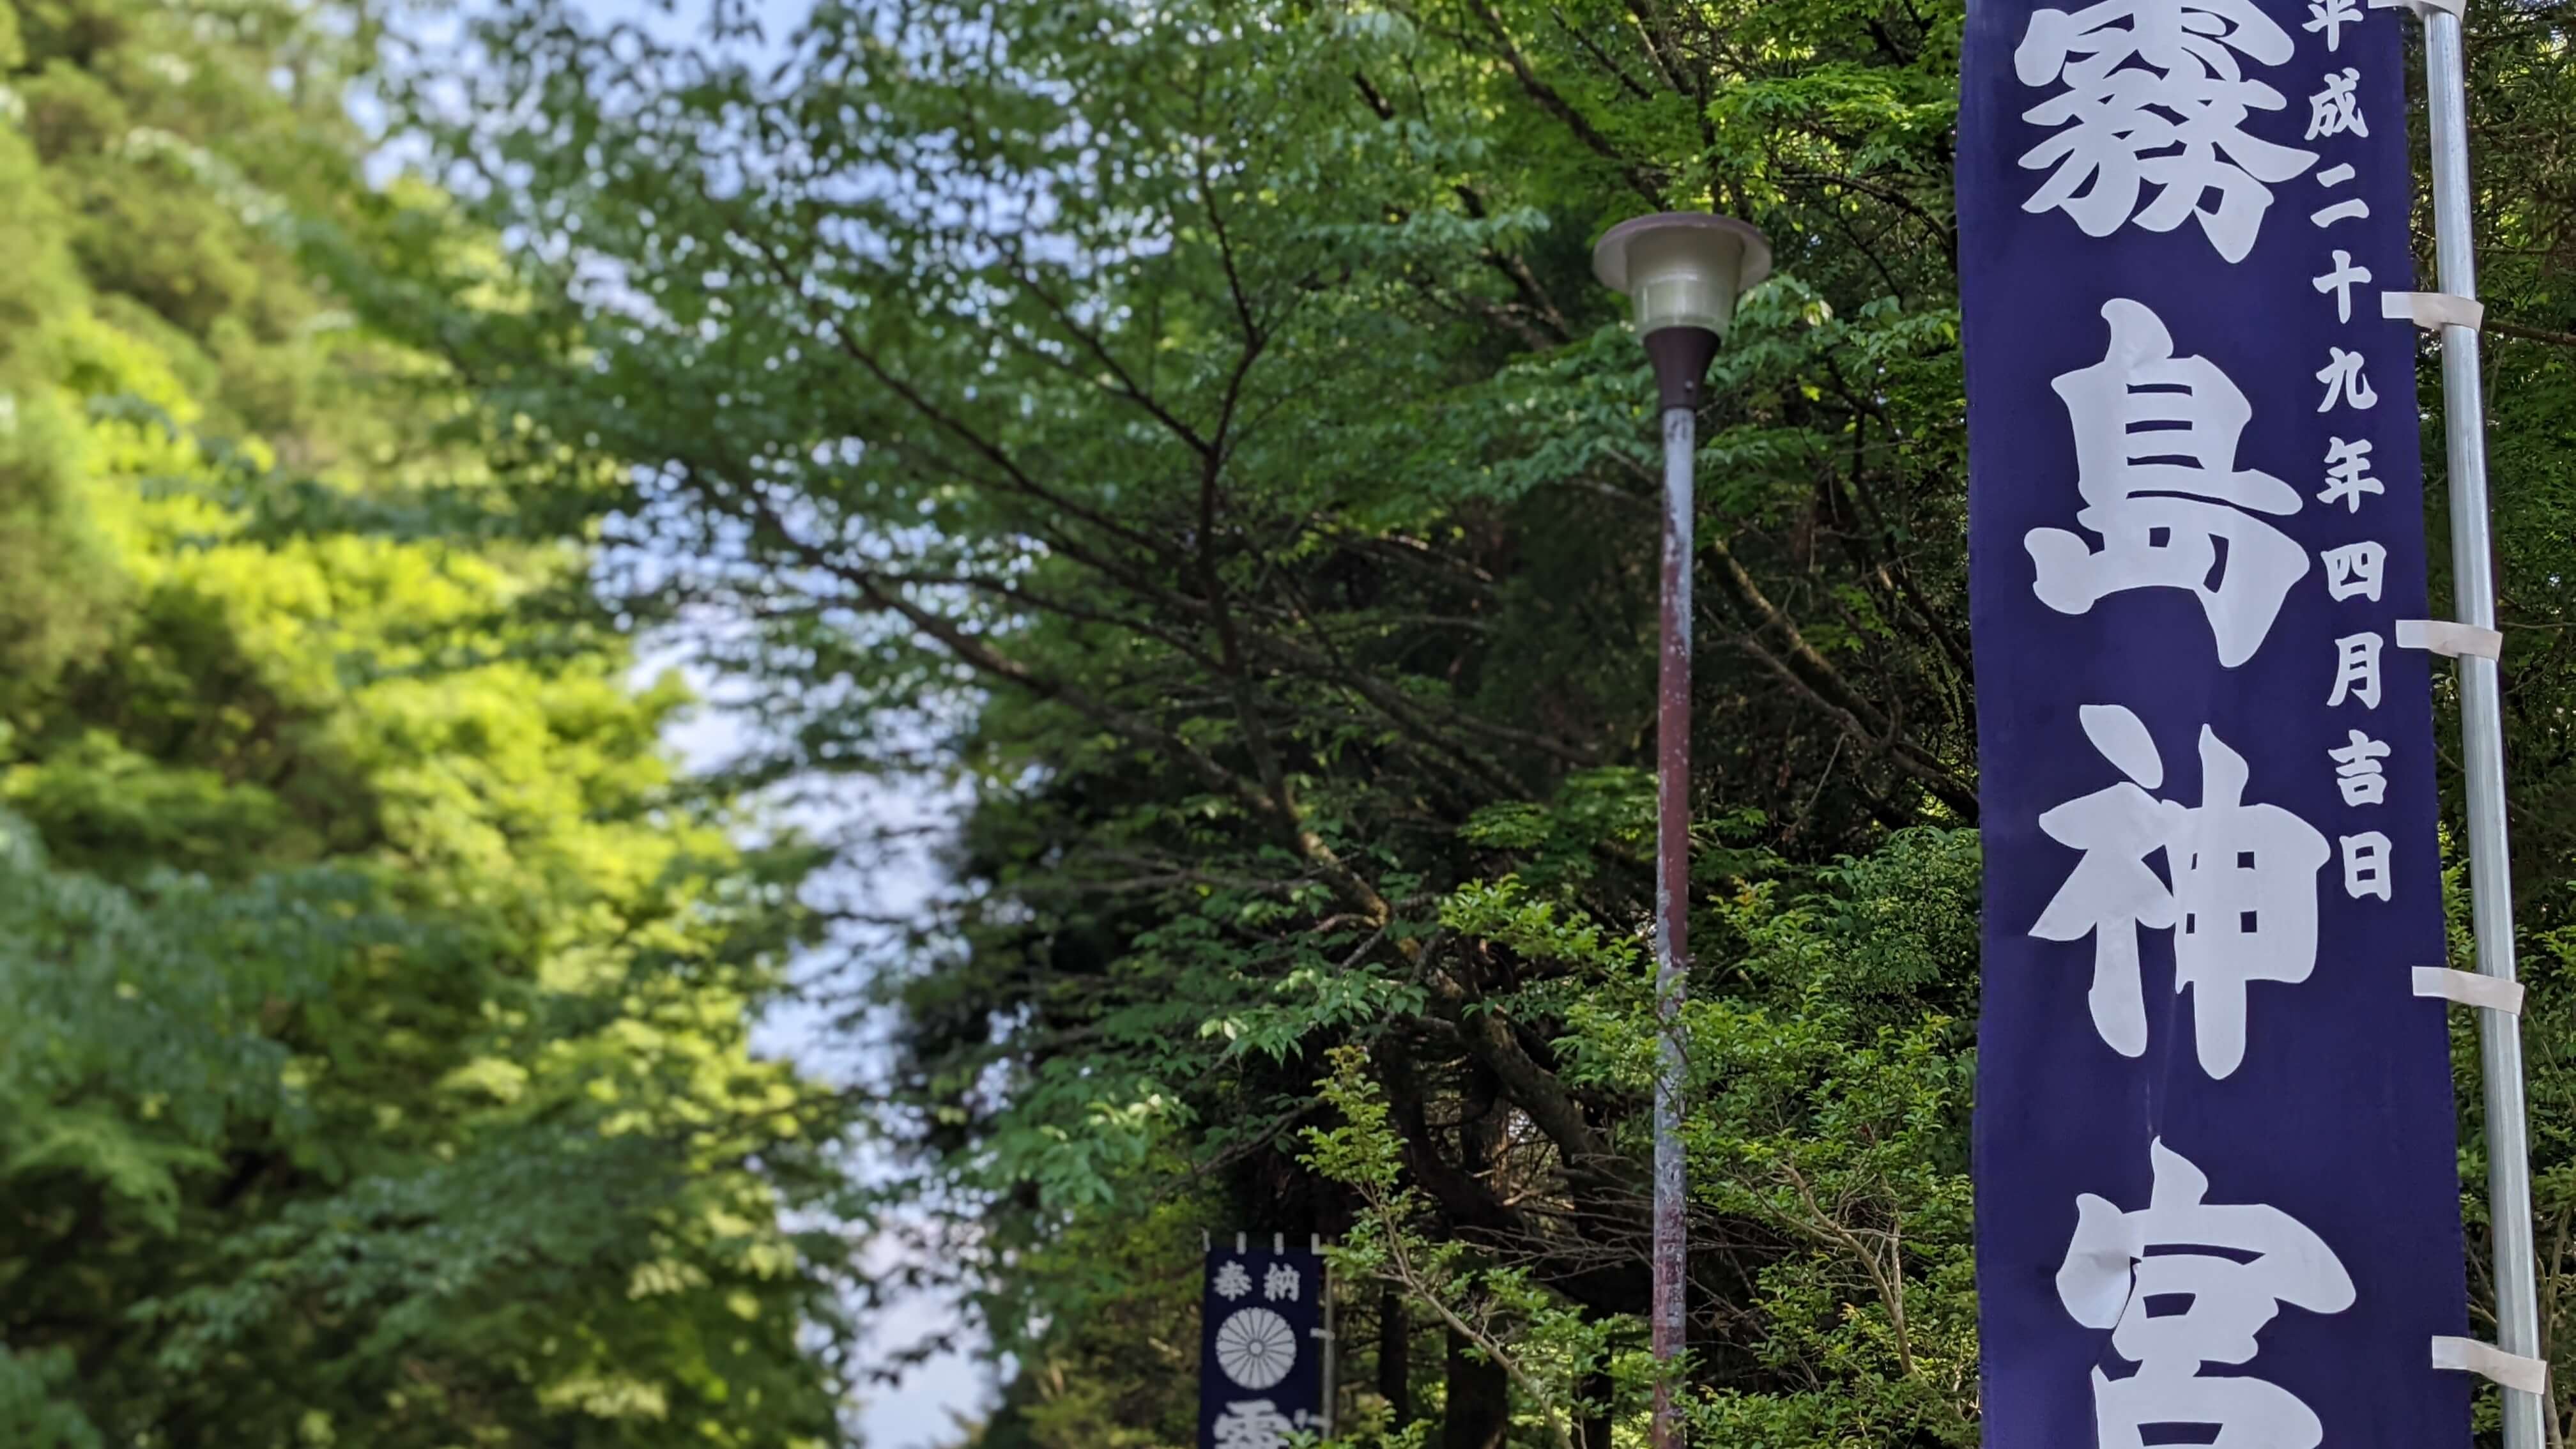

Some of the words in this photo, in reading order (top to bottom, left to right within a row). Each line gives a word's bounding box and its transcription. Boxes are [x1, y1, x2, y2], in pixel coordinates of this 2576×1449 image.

[2014, 0, 2356, 1449] 霧島神宮
[2302, 0, 2392, 901] 平成二十九年四月吉日
[1213, 1260, 1301, 1302] 奉納
